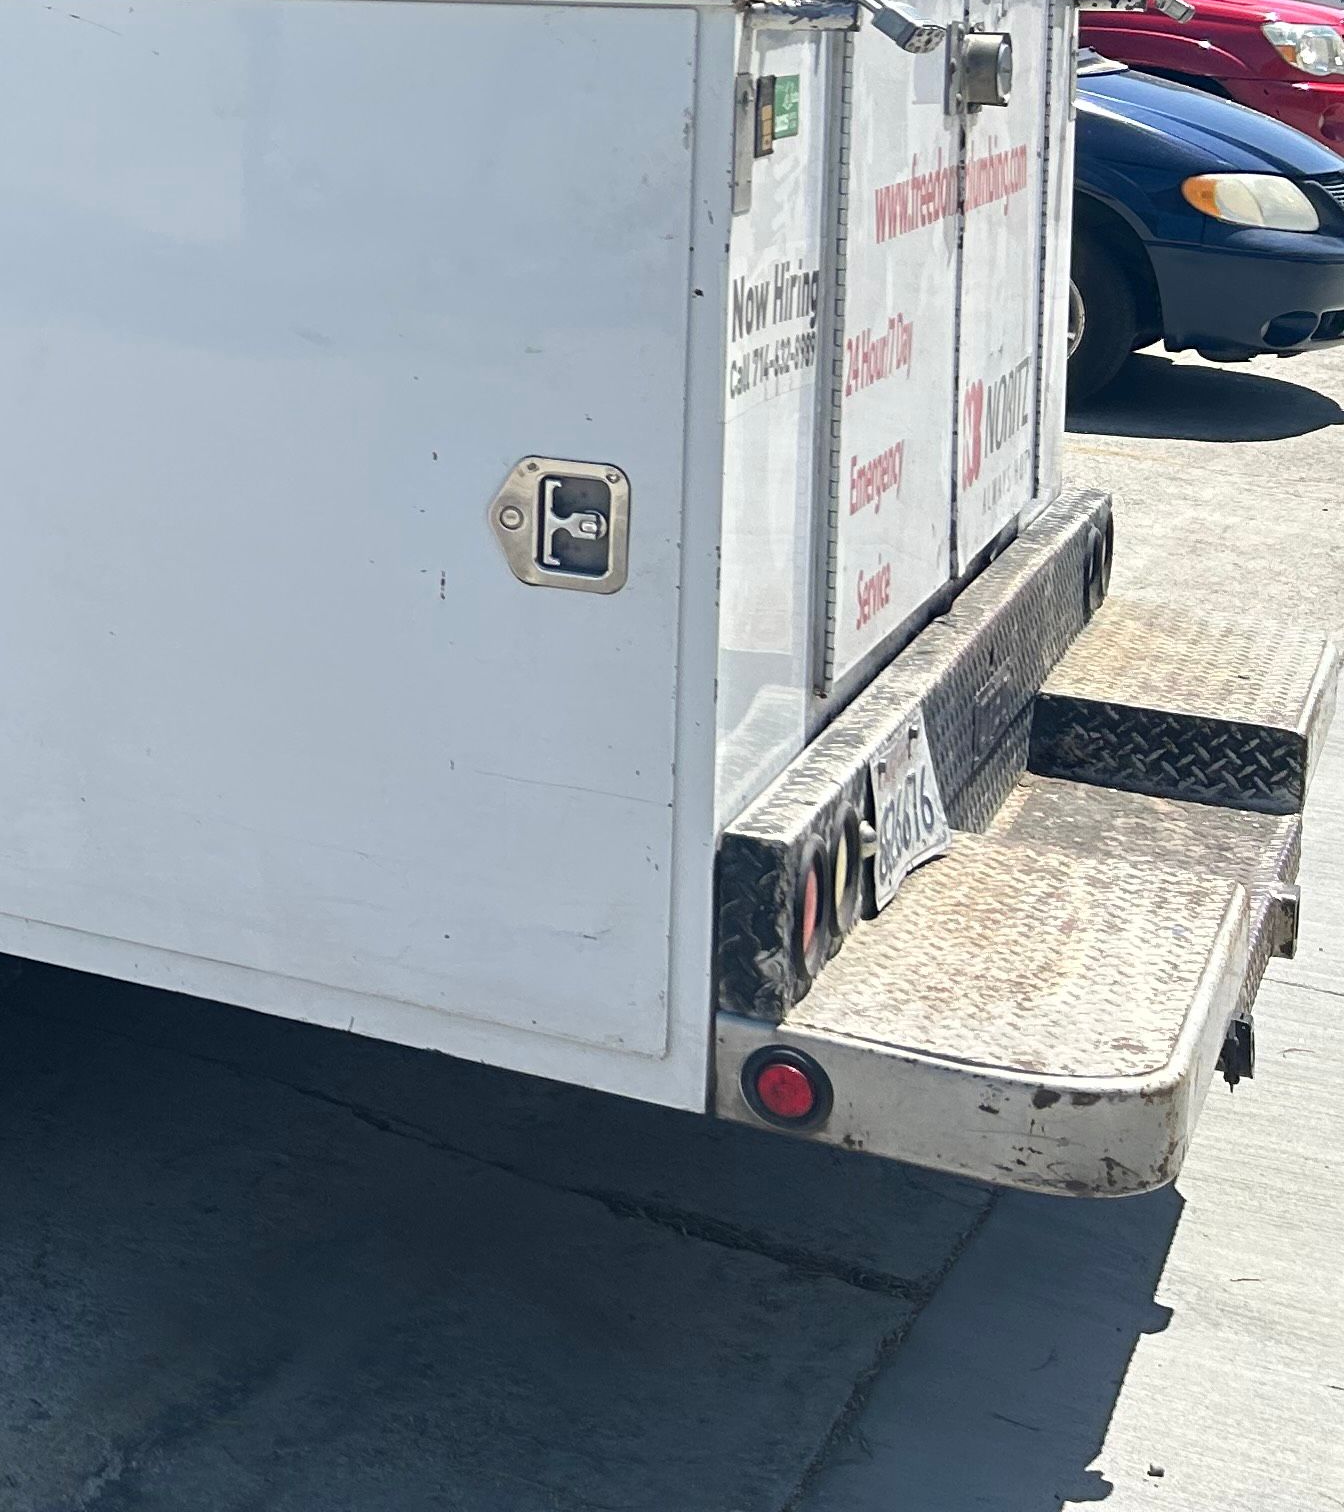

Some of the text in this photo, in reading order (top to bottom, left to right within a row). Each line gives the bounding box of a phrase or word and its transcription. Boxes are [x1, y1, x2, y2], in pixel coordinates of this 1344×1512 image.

[732, 258, 819, 343] Now Hiring
[849, 439, 905, 517] Emergency
[855, 552, 892, 631] Service
